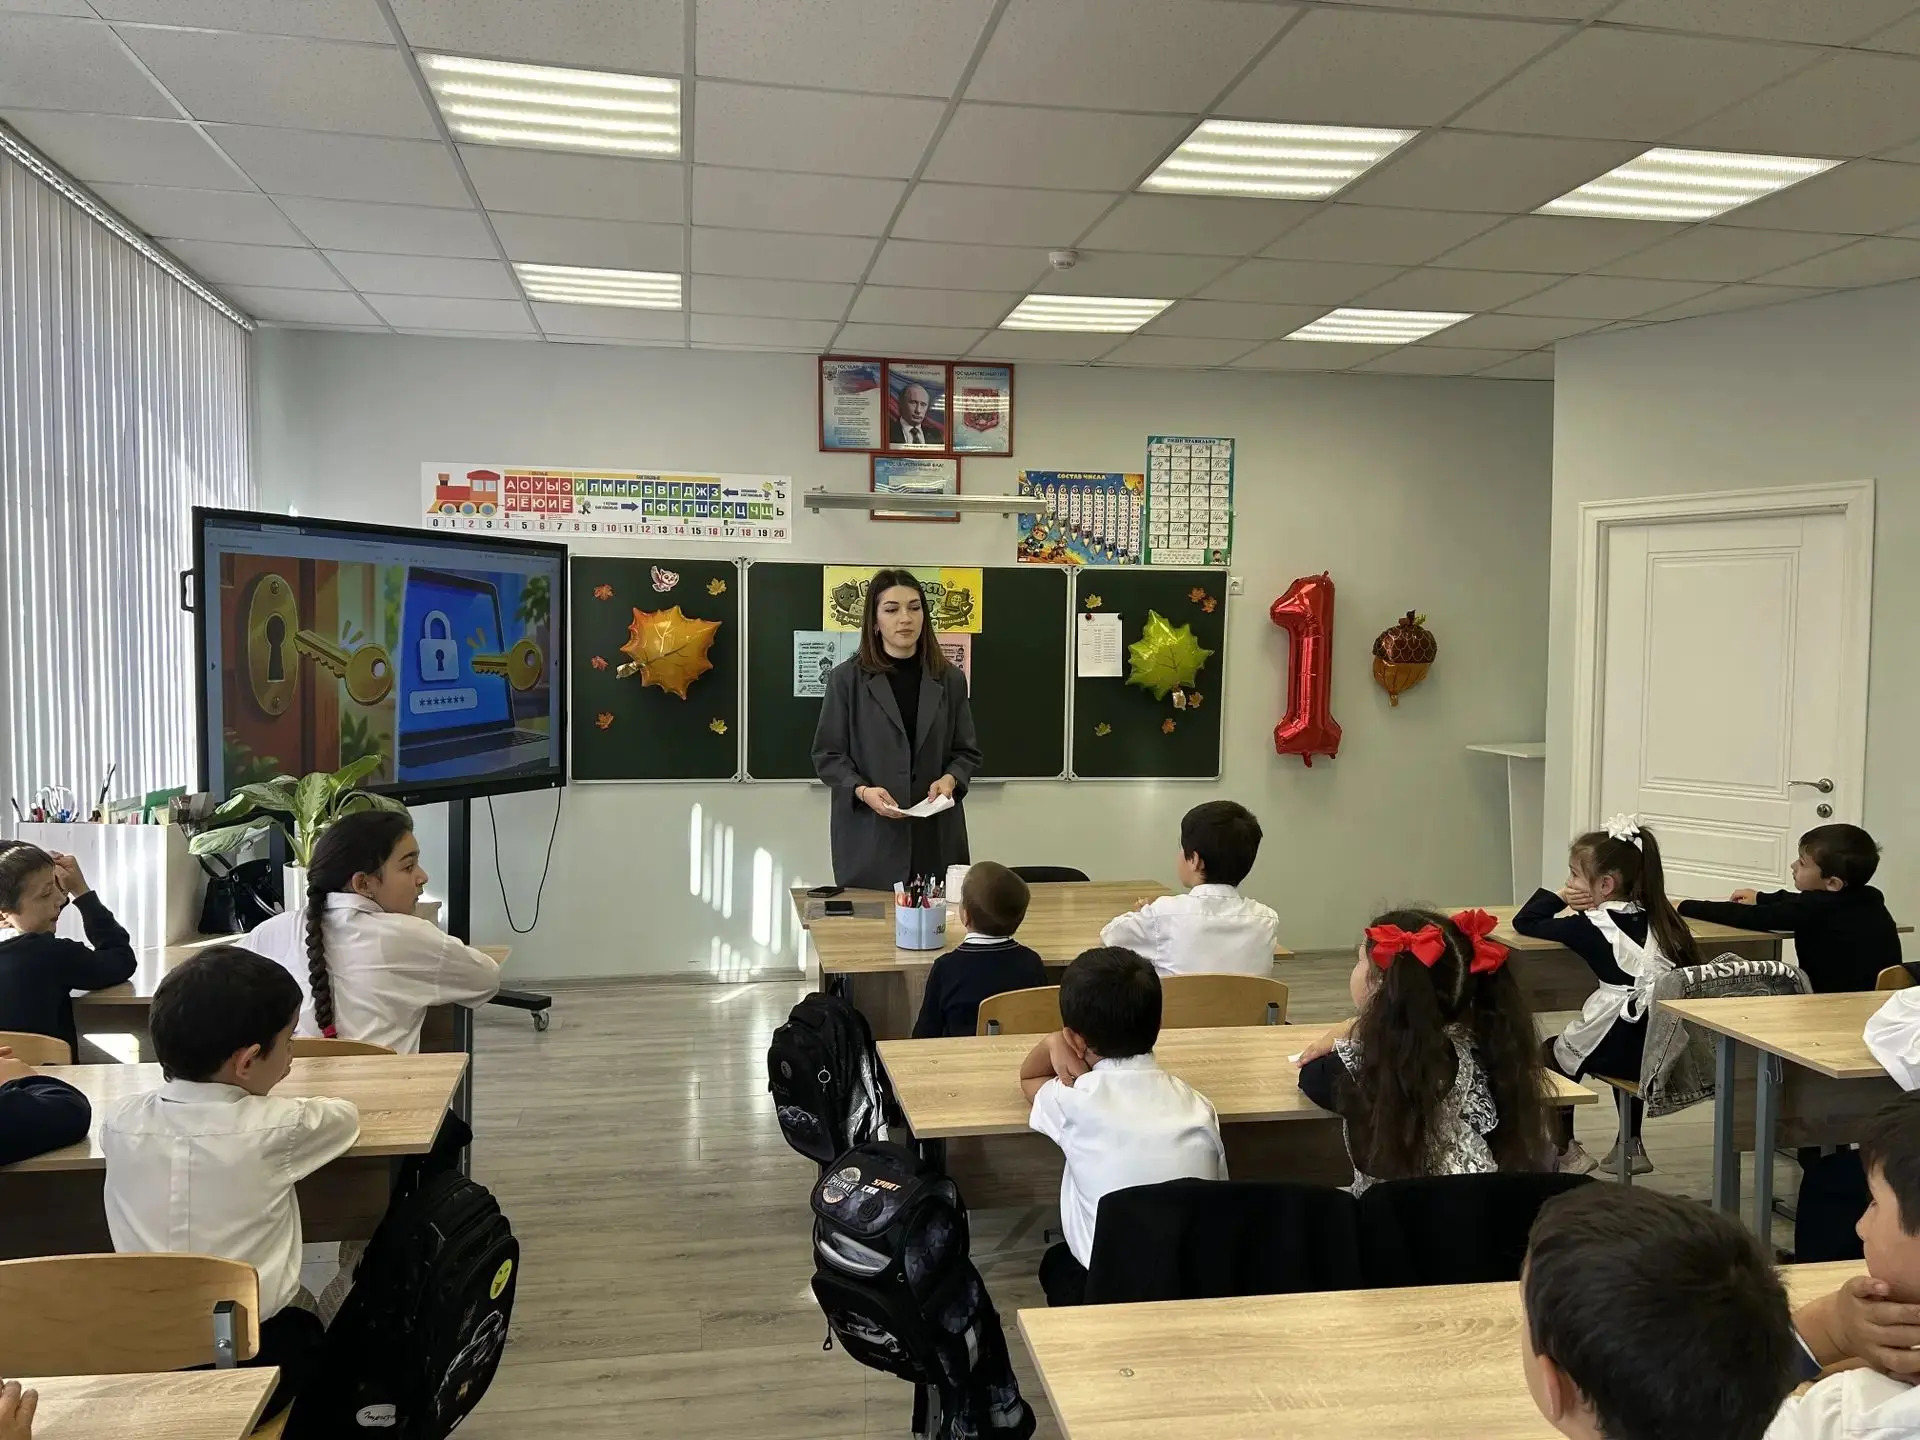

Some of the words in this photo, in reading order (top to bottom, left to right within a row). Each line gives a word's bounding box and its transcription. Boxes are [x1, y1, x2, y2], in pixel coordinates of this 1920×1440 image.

[486, 520, 492, 528] 3
[521, 521, 528, 530] 5
[827, 1175, 856, 1193] SPEEDWAY
[871, 1178, 901, 1191] SPORT
[861, 1185, 880, 1195] CAR
